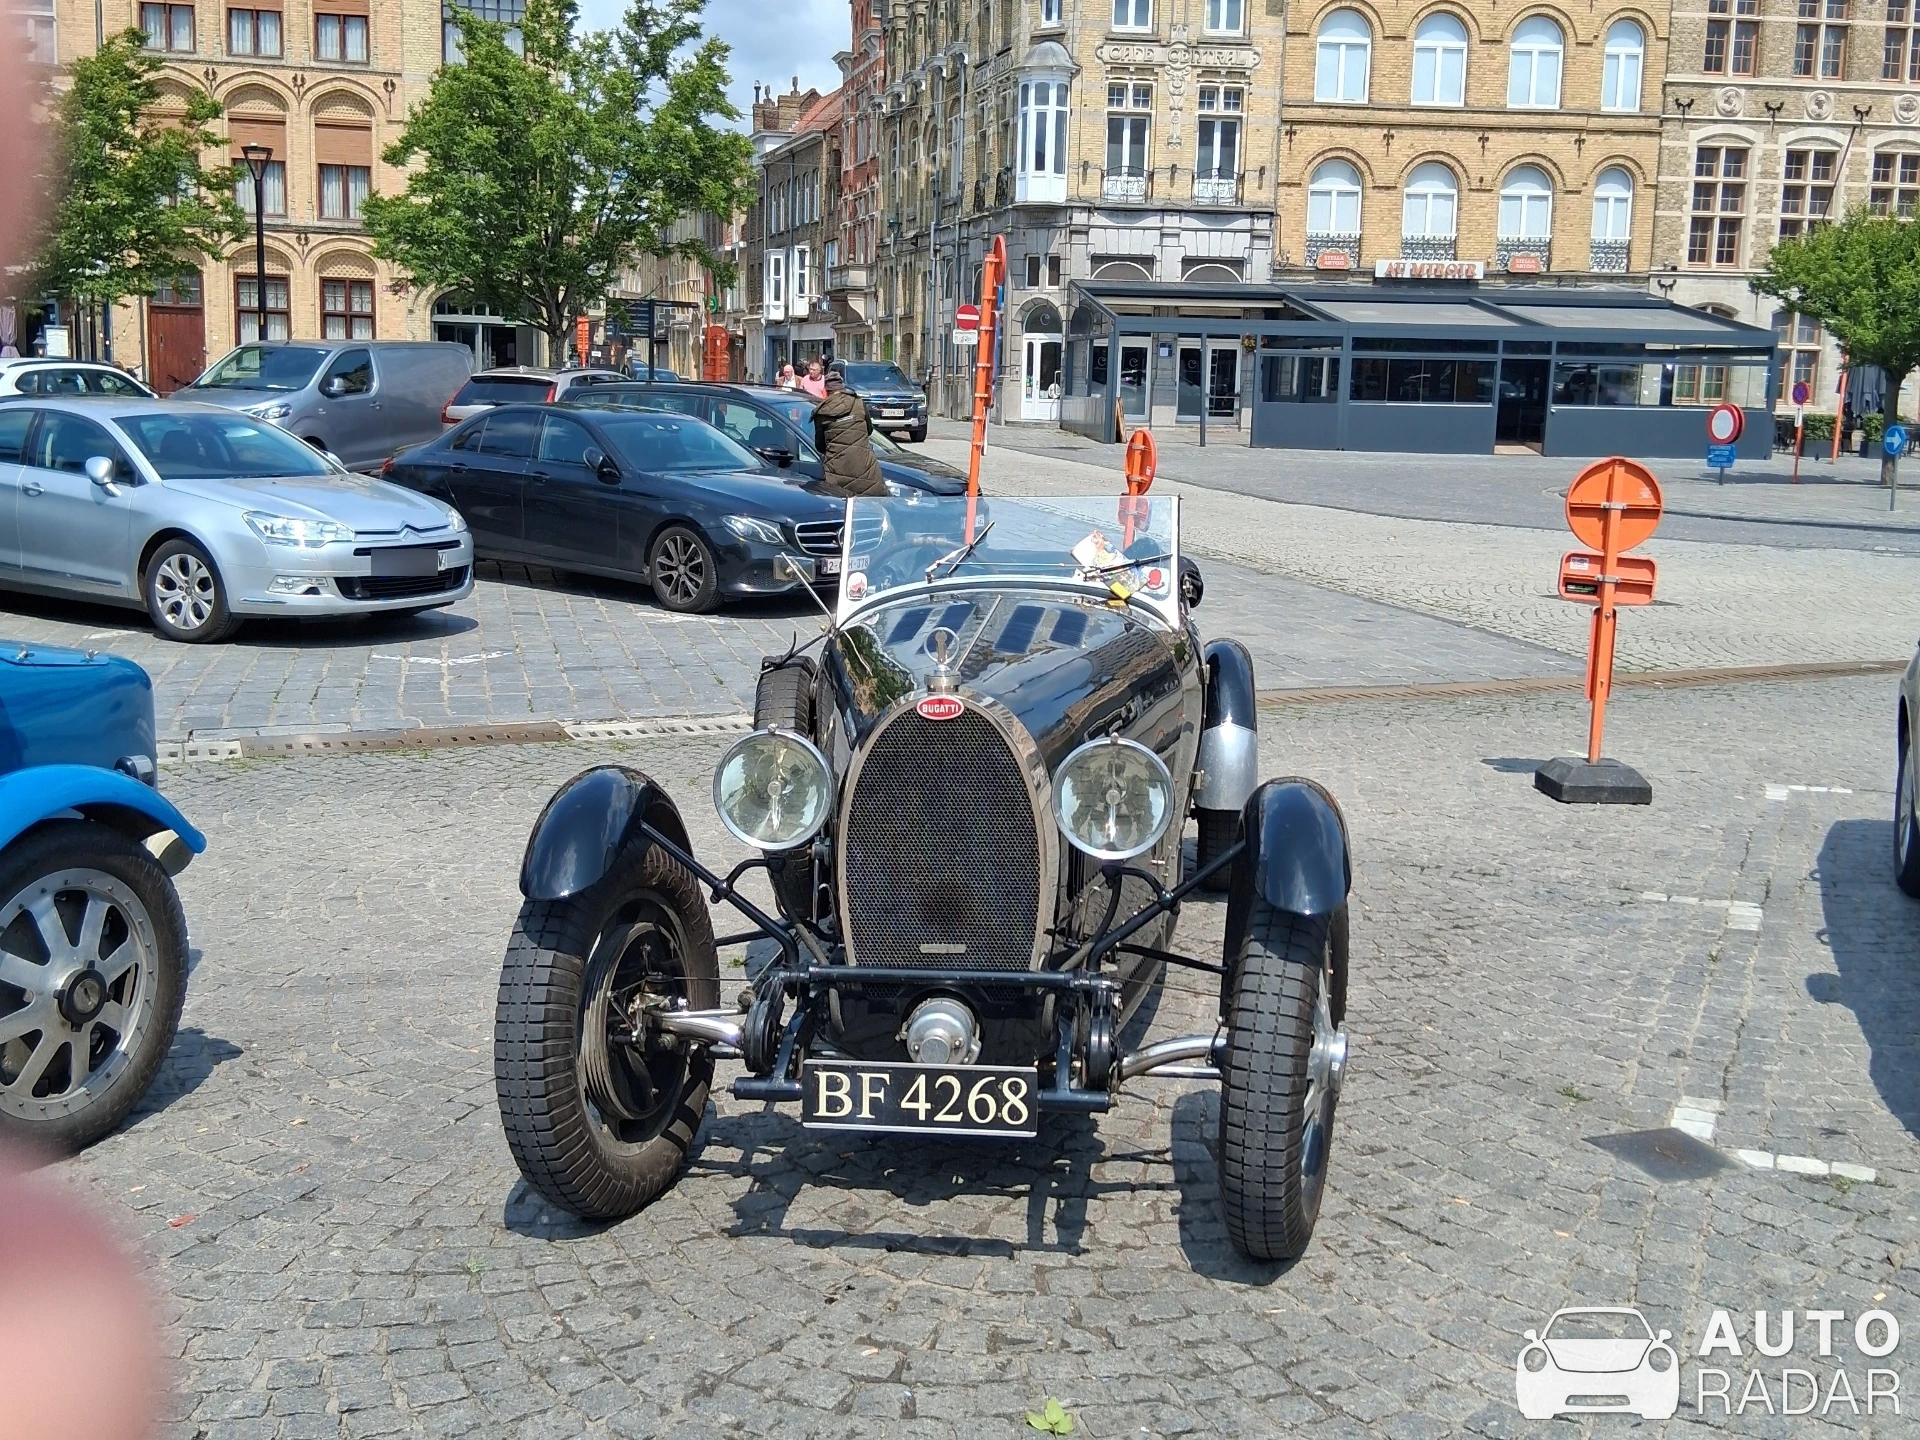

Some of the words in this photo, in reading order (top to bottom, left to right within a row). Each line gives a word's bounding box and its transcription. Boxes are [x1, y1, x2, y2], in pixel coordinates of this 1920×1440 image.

[1168, 49, 1247, 66] CENTRAL
[1385, 262, 1406, 277] AU
[1410, 262, 1477, 278] MIROIR
[922, 704, 959, 714] BUGATTI
[812, 1070, 891, 1119] BF
[900, 1073, 1029, 1125] 4268
